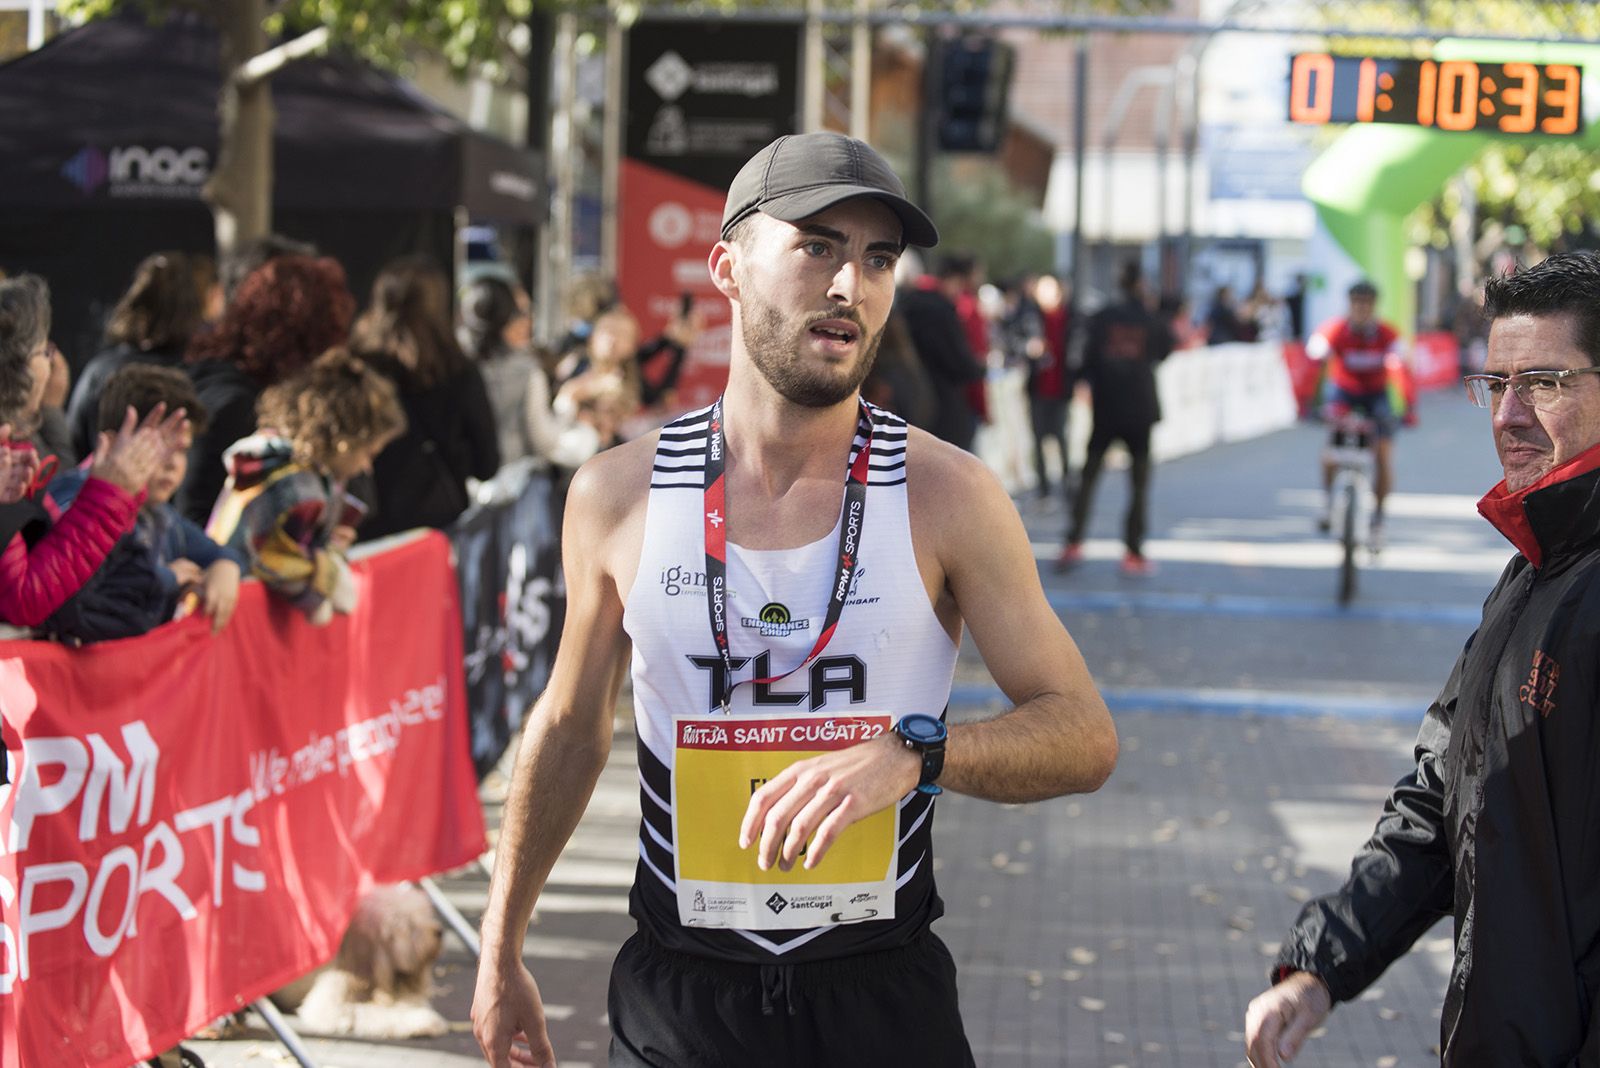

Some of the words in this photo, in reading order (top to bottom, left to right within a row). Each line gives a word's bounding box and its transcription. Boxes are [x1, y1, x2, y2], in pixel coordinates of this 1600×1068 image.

[711, 433, 720, 461] RPM
[835, 568, 850, 602] RPM
[845, 501, 861, 555] SPORTS
[713, 576, 723, 632] SPORTS
[741, 617, 810, 631] ENDURANCE
[760, 627, 792, 637] SHOP
[685, 649, 867, 713] TLA
[683, 727, 728, 744] MITJA
[734, 727, 787, 744] SANT
[790, 725, 858, 742] CUGAT
[860, 724, 884, 740] 22
[790, 901, 833, 909] SantCugat
